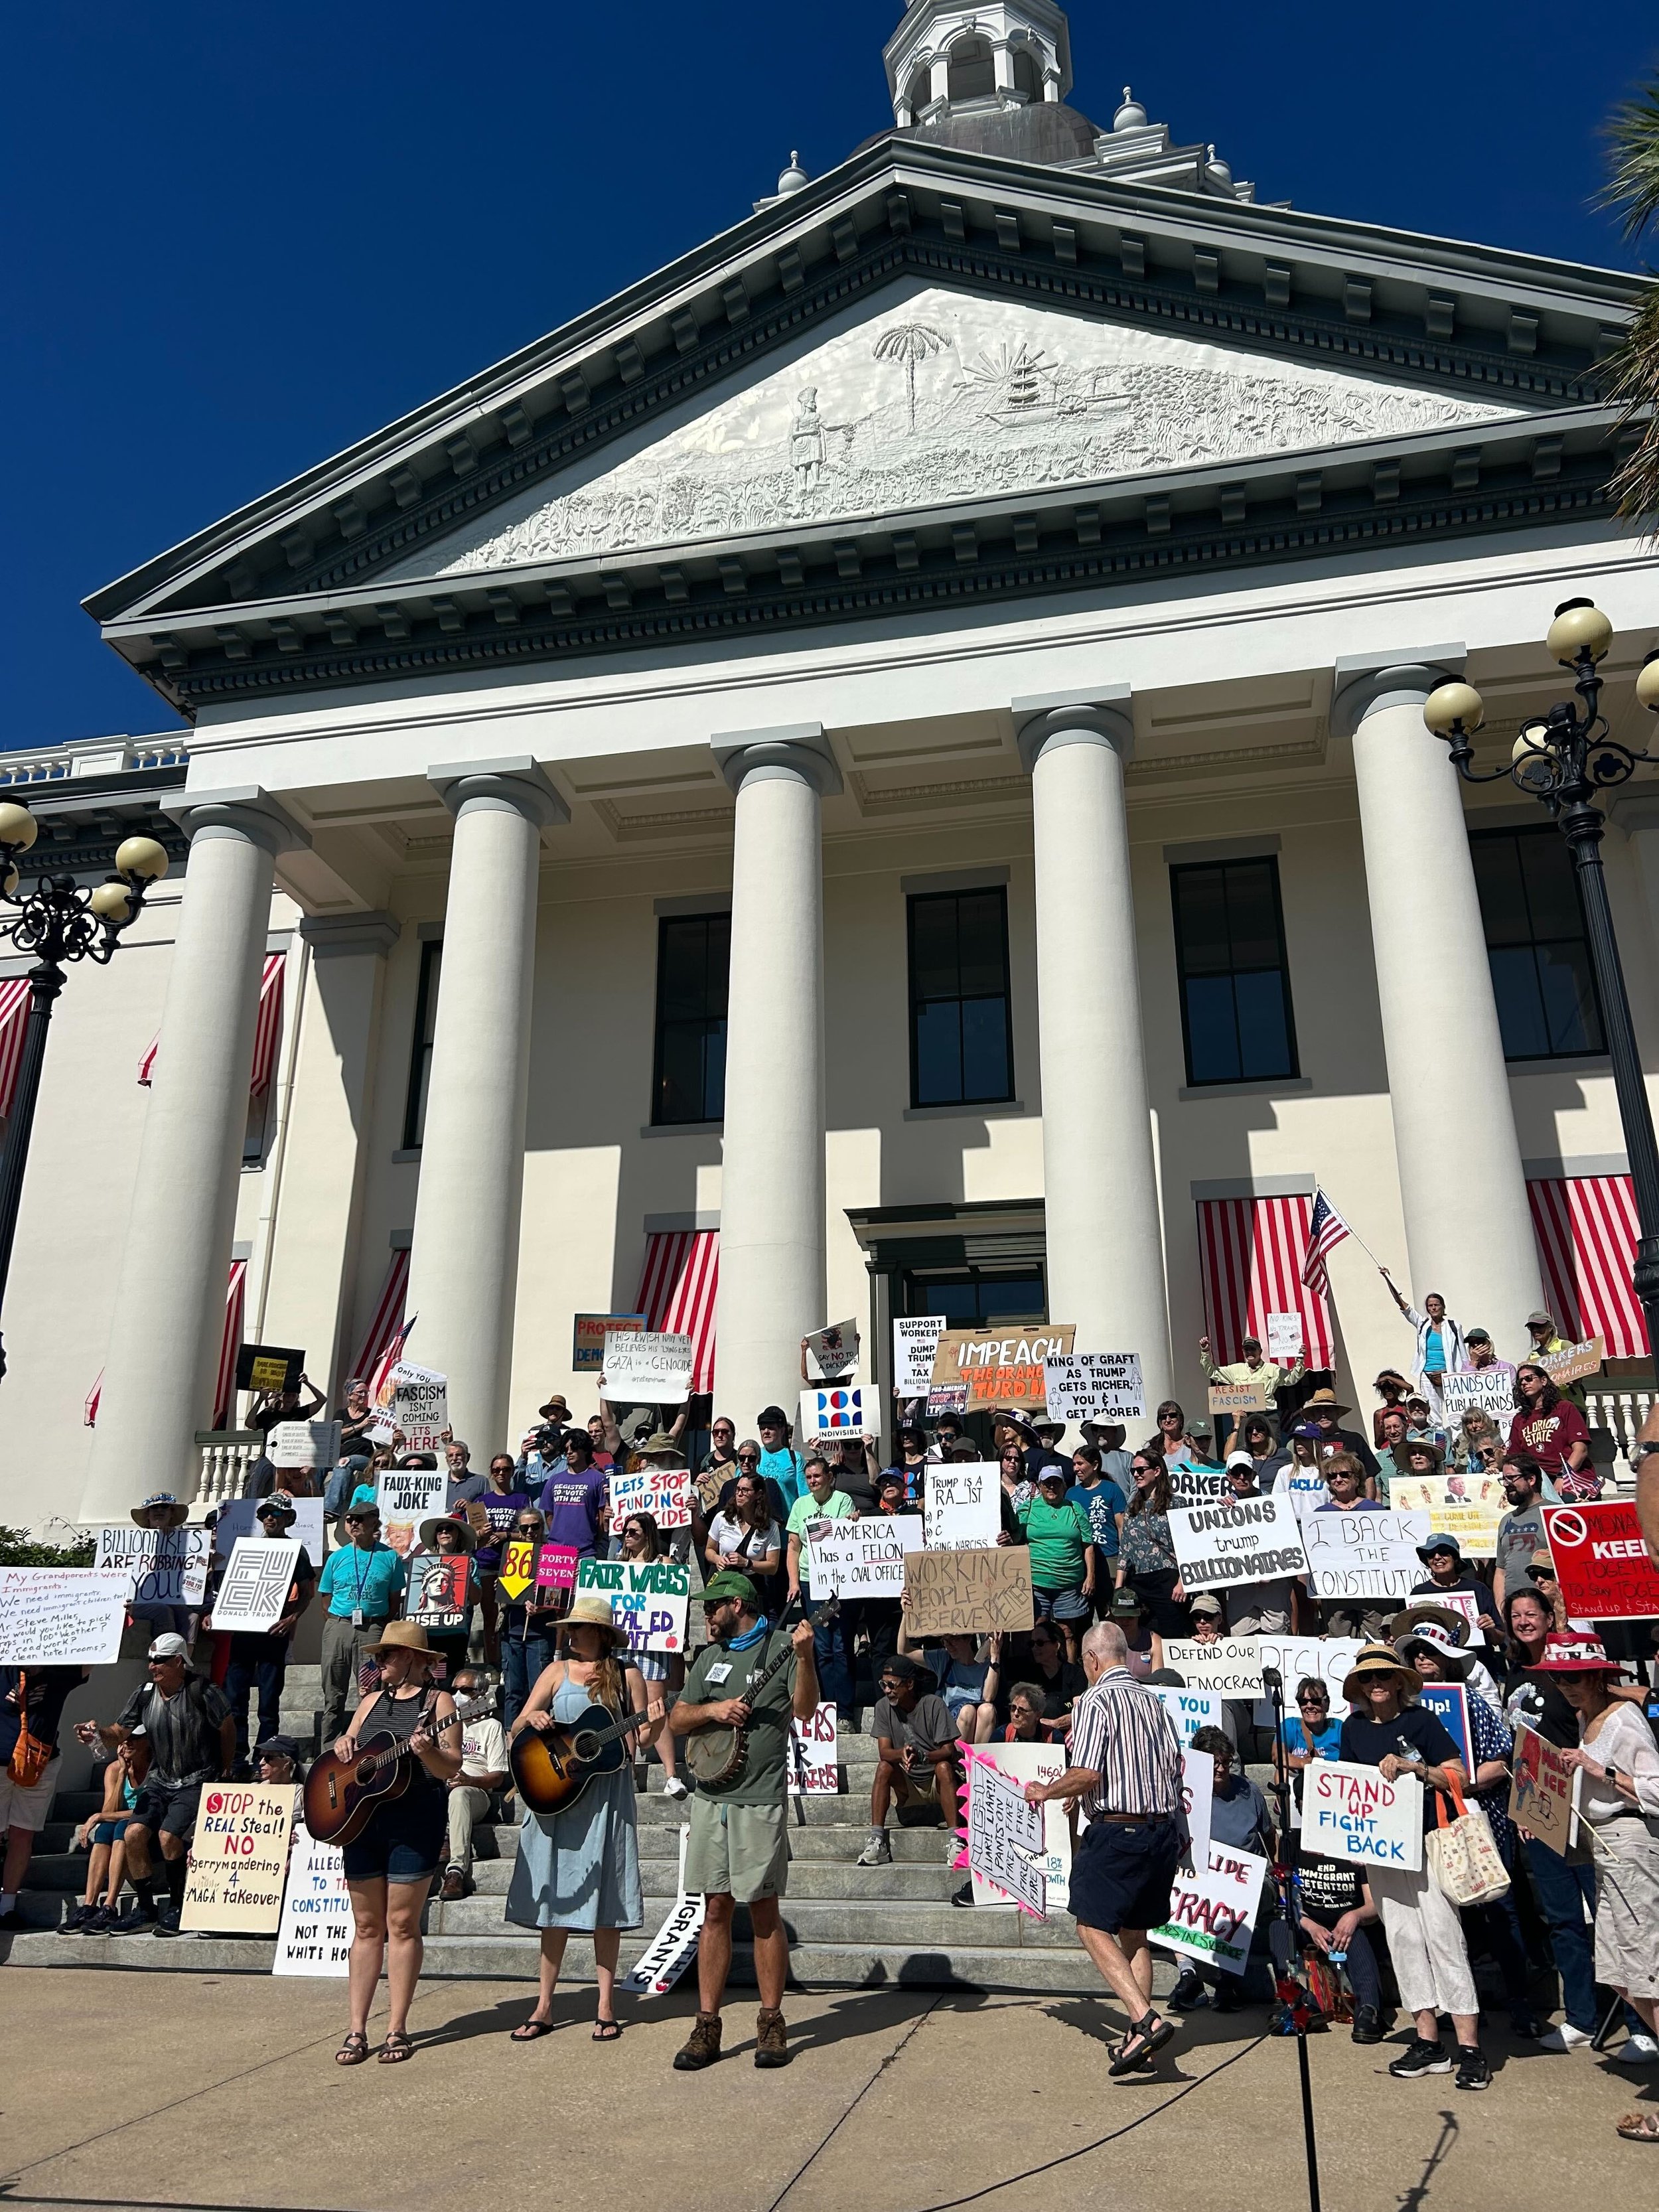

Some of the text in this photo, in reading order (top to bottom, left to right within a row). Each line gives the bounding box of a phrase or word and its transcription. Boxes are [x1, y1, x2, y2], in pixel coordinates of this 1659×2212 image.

[845, 486, 894, 502] GOD
[578, 1321, 642, 1335] PROTECT
[899, 1320, 942, 1329] SUPPORT
[615, 1344, 646, 1353] BELIEVES
[910, 1345, 935, 1354] DUMP
[958, 1337, 1063, 1368] IMPEACH
[607, 1356, 692, 1372] GAZA GENOCIDE
[1047, 1355, 1135, 1368] KING OF GRAFT
[1546, 1359, 1572, 1372] OVER
[397, 1366, 431, 1383] Only YOU
[960, 1367, 993, 1382] THE
[1066, 1367, 1126, 1379] AS TRUMP
[974, 1380, 1026, 1400] TURD
[1059, 1380, 1133, 1392] GETS RICHER,
[1215, 1384, 1251, 1394] RESIST
[1444, 1371, 1509, 1394] HANDS OFF
[397, 1385, 447, 1402] FASCISM
[930, 1393, 950, 1404] STOP
[1072, 1396, 1095, 1406] YOU
[1212, 1395, 1257, 1406] FASCISM
[409, 1401, 434, 1412] ISN'T
[1445, 1393, 1514, 1413] PUBLIC LANDS
[377, 1408, 388, 1417] Can
[402, 1412, 440, 1423] COMING
[1066, 1409, 1087, 1419] GET
[411, 1426, 431, 1436] ITS
[819, 1428, 863, 1438] INDIVISIBLE
[1521, 1416, 1561, 1438] FLORIDA
[403, 1436, 441, 1451] HERE
[1525, 1430, 1555, 1447] STATE
[384, 1477, 443, 1491] FAUX-KING
[614, 1472, 689, 1496] LET'S STOP
[930, 1475, 982, 1489] TRUMP IS A
[1289, 1478, 1325, 1491] ACLU
[394, 1492, 430, 1509] JOKE
[618, 1491, 684, 1515] FUNDING
[926, 1510, 943, 1523] a) P
[1189, 1501, 1276, 1533] UNIONS
[833, 1524, 895, 1540] AMERICA
[926, 1525, 942, 1538] b) C
[1340, 1516, 1418, 1544] BACK
[103, 1529, 203, 1554] BILLIONAIRES
[1213, 1534, 1259, 1552] trump
[541, 1554, 577, 1564] FORTY
[820, 1543, 904, 1563] has a FELON
[1354, 1547, 1390, 1562] THE
[139, 1554, 195, 1572] ROBBING
[503, 1547, 534, 1579] 86
[906, 1554, 1023, 1584] WORKING
[1179, 1547, 1305, 1585] BILLIONAIRES
[6, 1573, 27, 1586] My
[33, 1572, 98, 1581] Grandparents
[538, 1568, 576, 1578] SEVEN
[579, 1560, 690, 1595] FAIR WAGES
[818, 1564, 904, 1585] in the OVAL OFFICE
[132, 1571, 181, 1601] YOU!
[0, 1594, 49, 1607] We need
[611, 1594, 647, 1611] FOR
[908, 1578, 1030, 1631] DESERVE BETTER
[909, 1584, 979, 1609] PEOPLE
[21, 1596, 111, 1615] need children
[1605, 1604, 1621, 1614] up
[13, 1627, 36, 1638] would
[40, 1627, 54, 1637] you
[89, 1613, 111, 1625] pick
[17, 1618, 48, 1629] Steve
[444, 1614, 464, 1627] UP
[650, 1611, 674, 1633] ED
[12, 1647, 67, 1662] clean hotel
[1169, 1645, 1255, 1660] DEFEND OUR
[1179, 1696, 1210, 1714] YOU
[1421, 1698, 1451, 1714] Up!
[1317, 1773, 1395, 1806] STAND
[1544, 1772, 1567, 1799] ICE
[208, 1793, 283, 1815] STOP the
[1348, 1799, 1374, 1818] UP
[204, 1816, 285, 1838] REAL Steal!
[984, 1779, 996, 1871] LIAR!! LIAR!!
[1319, 1811, 1378, 1834] FIGHT
[995, 1798, 1005, 1870] PANTS ON
[1005, 1797, 1015, 1881] FIRE FIRE
[224, 1835, 254, 1854] NO
[1016, 1801, 1029, 1893] FIRE FIRE
[1347, 1834, 1405, 1861] BACK
[191, 1858, 280, 1876] gerrymandering
[1046, 1857, 1062, 1870] 18%
[1317, 1864, 1336, 1872] END
[228, 1870, 240, 1888] 4
[1298, 1868, 1355, 1881] IMMIGRANT
[313, 1876, 326, 1891] TO
[1030, 1869, 1039, 1904] FIRE
[186, 1887, 216, 1903] MAGA
[295, 1925, 347, 1939] NOT THE
[287, 1945, 323, 1960] WHITE
